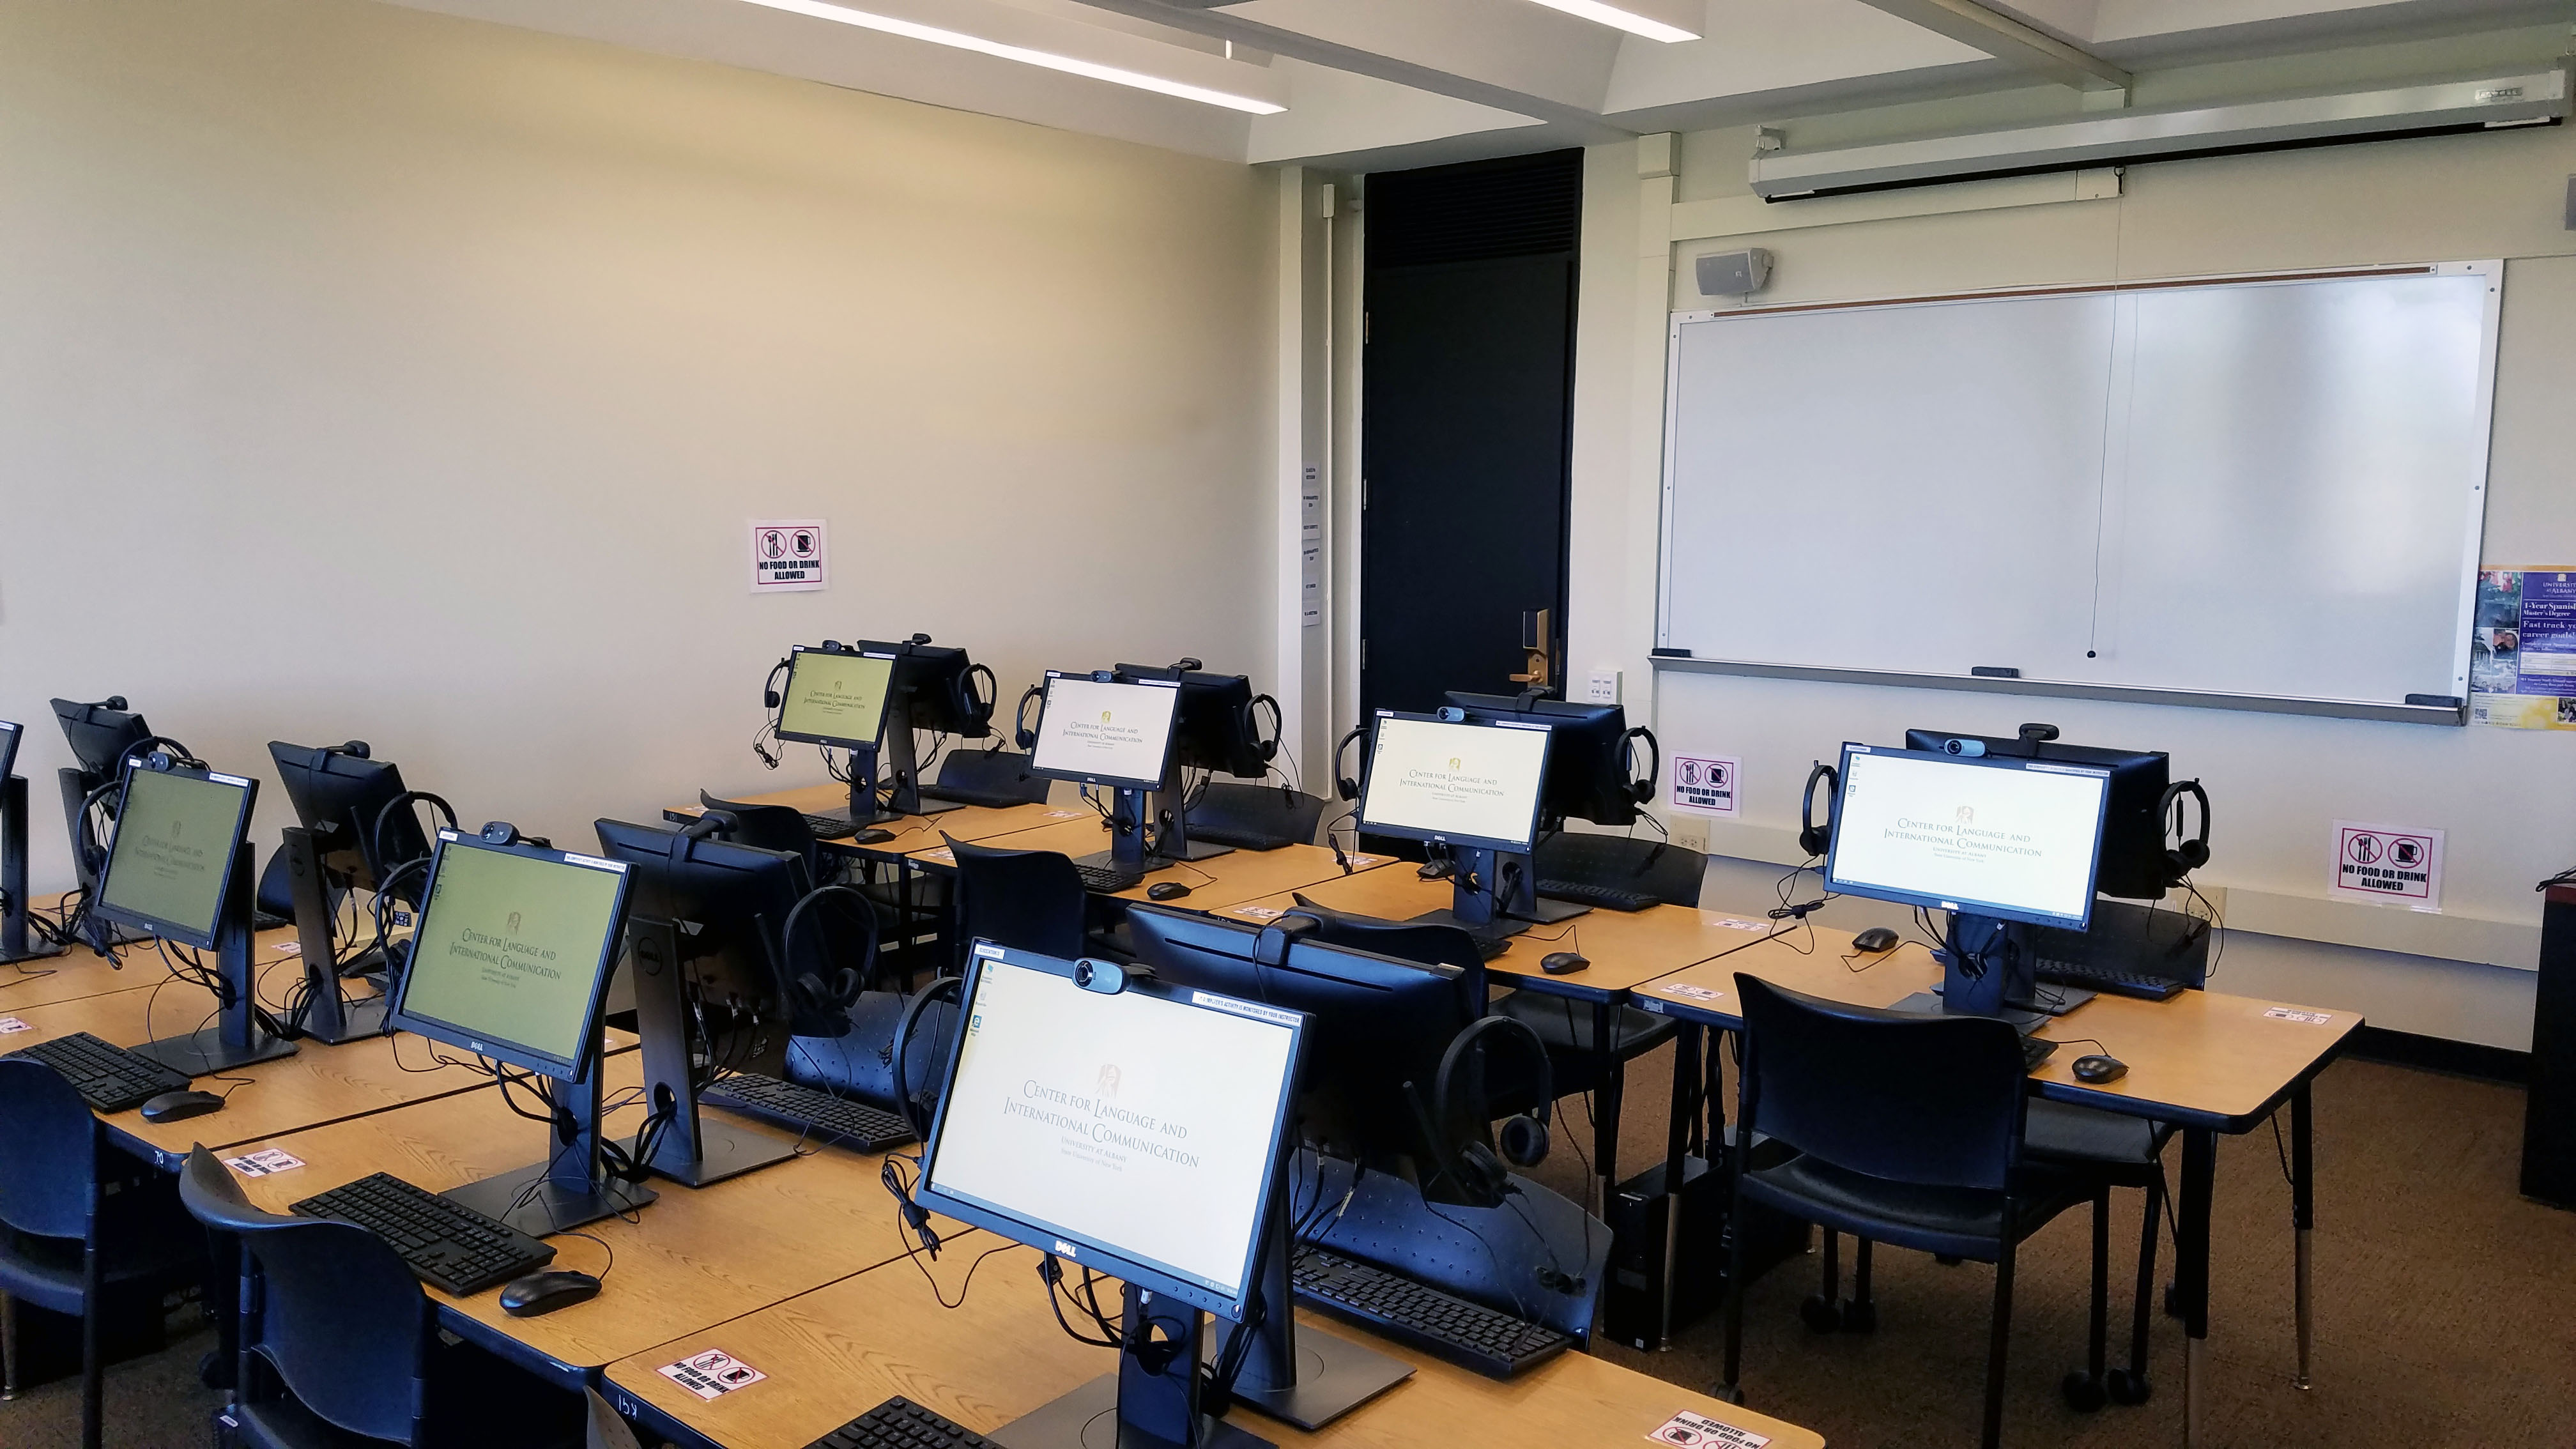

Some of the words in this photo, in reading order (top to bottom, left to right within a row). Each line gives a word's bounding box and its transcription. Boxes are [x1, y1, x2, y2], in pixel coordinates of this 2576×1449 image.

[759, 562, 768, 570] NO
[770, 561, 787, 570] FOOD
[799, 560, 820, 569] DRINK
[774, 571, 805, 580] ALLOWED
[1685, 786, 1701, 795] FOOD
[1711, 789, 1731, 799] DRINK
[1689, 795, 1716, 806] ALLOWED
[2342, 864, 2355, 873] NO
[2357, 866, 2380, 877] FOOD
[2382, 869, 2395, 879] OR
[2397, 871, 2426, 882] DRINK
[2361, 878, 2404, 891] ALLOWED
[1023, 1079, 1068, 1105] CENTER
[1070, 1095, 1091, 1112] FOR
[1093, 1098, 1156, 1130] LANGUAGE
[1160, 1122, 1188, 1139] AND
[1003, 1096, 1089, 1135] INTERNATIONAL
[1092, 1123, 1199, 1169] COMMUNICATION
[1055, 1241, 1077, 1257] DELL
[673, 1374, 705, 1390] ALLOWED
[681, 1367, 702, 1377] FOOD
[706, 1381, 731, 1393] DRINK
[1673, 1416, 1704, 1430] DRINK
[1701, 1420, 1746, 1437] ALLOWED
[1719, 1432, 1745, 1444] FOOD
